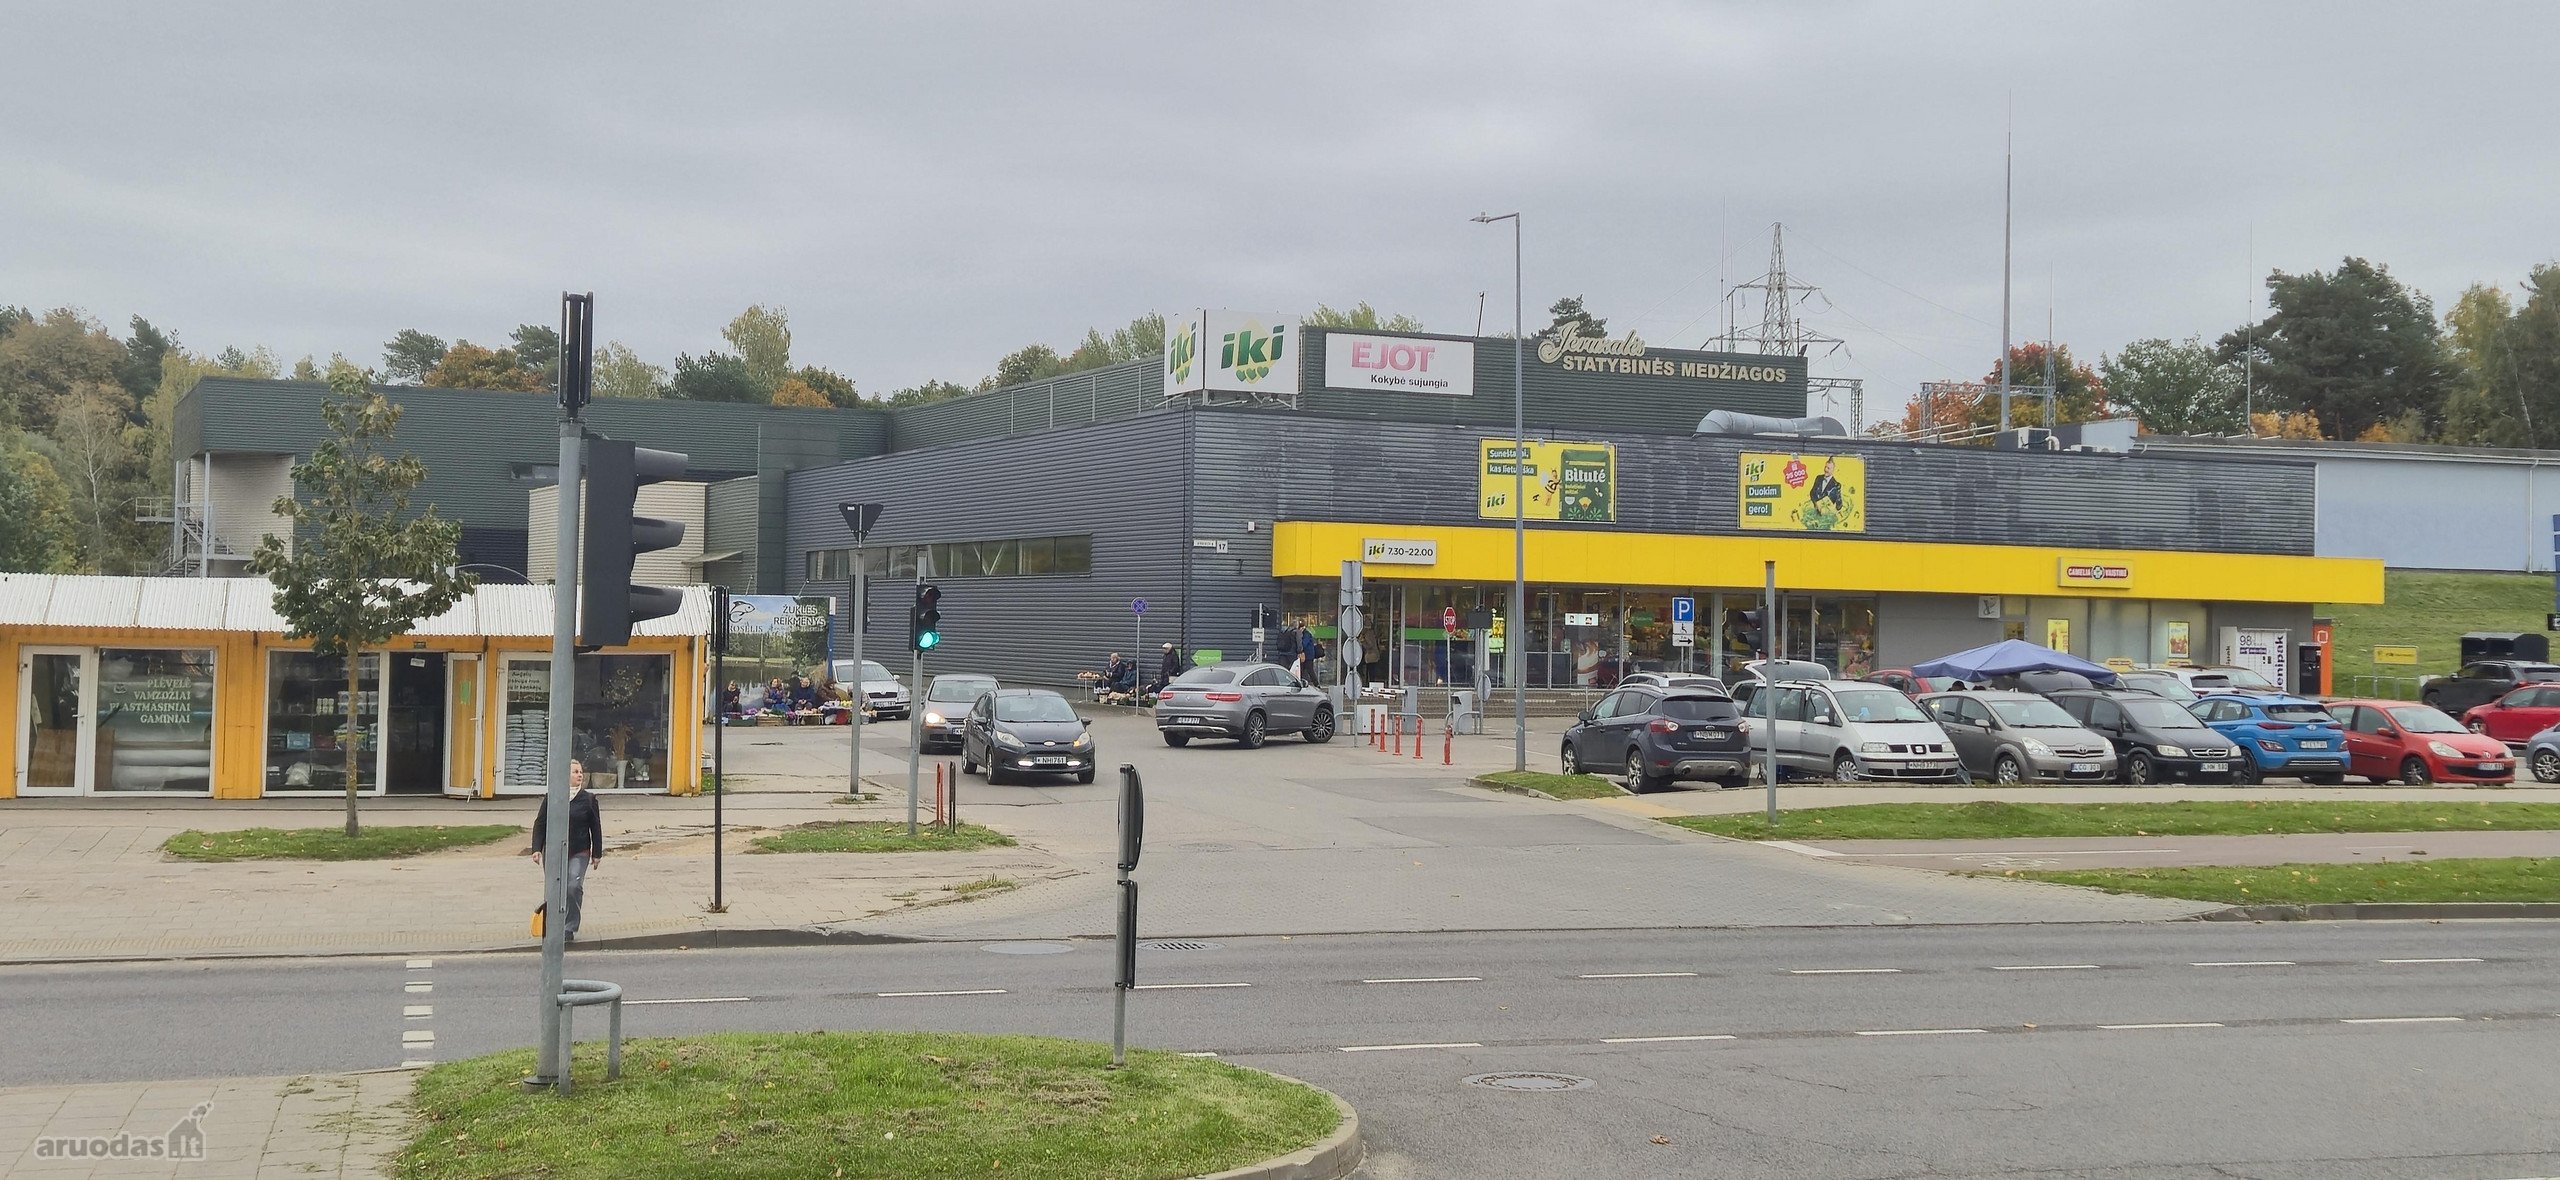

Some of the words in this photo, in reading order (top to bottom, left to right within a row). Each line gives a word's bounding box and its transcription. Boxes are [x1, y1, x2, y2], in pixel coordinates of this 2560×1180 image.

[1169, 321, 1197, 375] iki
[1221, 324, 1285, 369] iki
[1352, 341, 1435, 372] EJOT
[1562, 356, 1675, 376] STATYBINĖS
[1681, 361, 1787, 383] MEDŽIAGOS
[1370, 375, 1405, 386] Kokybė
[1409, 377, 1449, 389] sujungia
[1745, 461, 1764, 475] iki
[1748, 486, 1776, 495] Duokim
[1486, 493, 1506, 508] iki
[1748, 504, 1768, 514] gero!
[1368, 543, 1386, 556] iki
[1678, 600, 1690, 620] P
[774, 617, 825, 626] REIKMENYS
[1445, 615, 1456, 626] STOP
[2239, 635, 2252, 646] 98
[2274, 635, 2285, 686] enipak
[147, 677, 191, 688] PLĖVELĖ
[109, 702, 191, 712] PLASTMASINIAI
[140, 713, 190, 724] GAMINIAI
